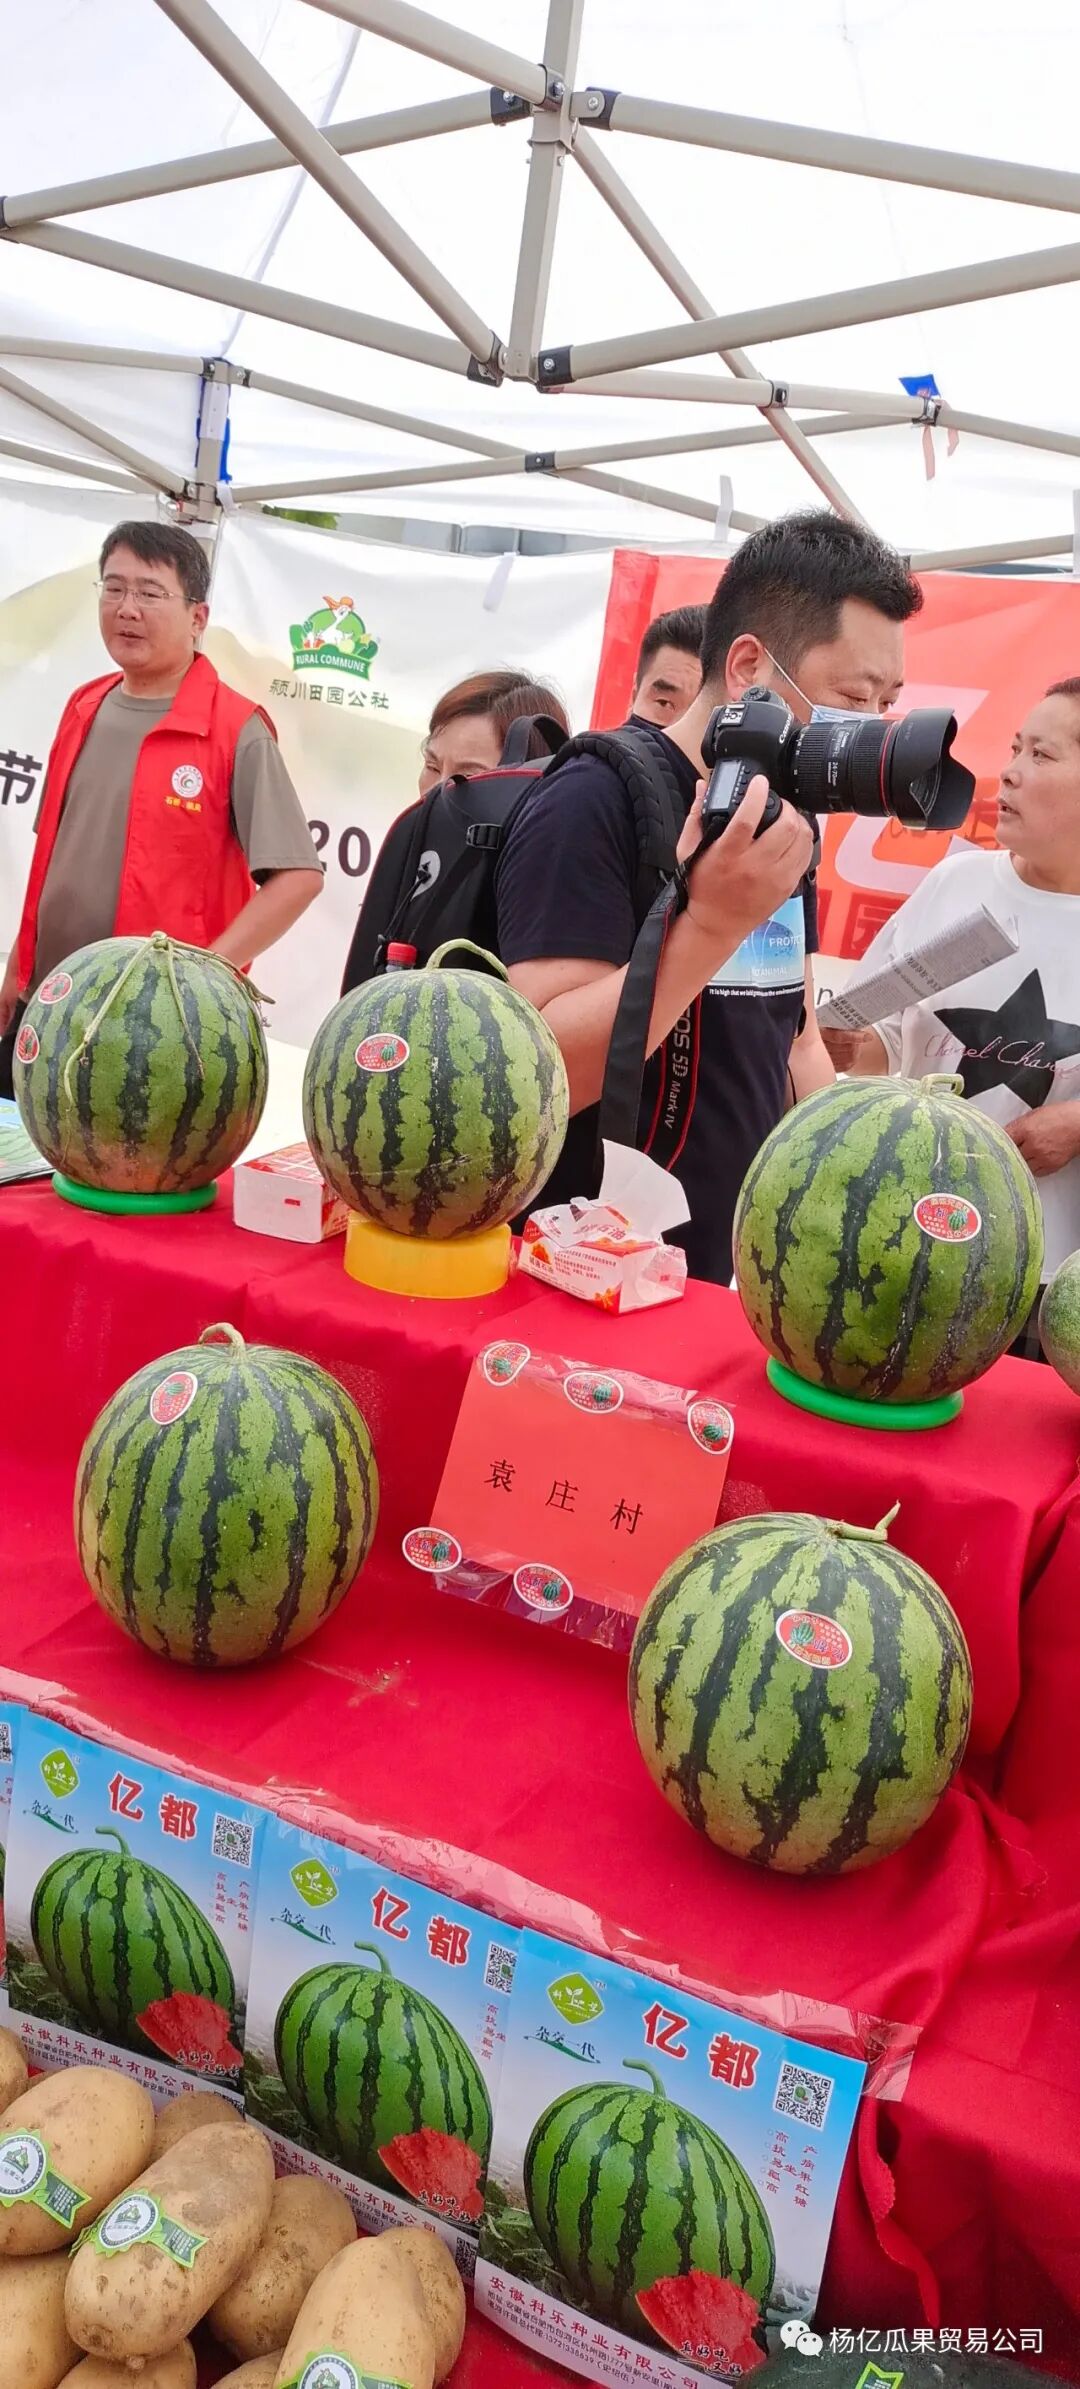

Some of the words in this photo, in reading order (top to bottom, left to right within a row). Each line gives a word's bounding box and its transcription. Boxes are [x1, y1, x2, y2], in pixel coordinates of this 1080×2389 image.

[296, 653, 319, 666] RURAL
[320, 654, 366, 673] COMMUNE
[779, 713, 792, 744] Canon
[666, 1080, 681, 1113] Mark
[672, 1053, 689, 1077] 5D
[663, 1117, 676, 1129] IV
[483, 1458, 644, 1535] 袁庄村
[107, 1771, 201, 1843] 亿都
[371, 1886, 471, 1968] 亿都
[21, 2022, 194, 2091] 安徽科乐种业有限公司
[642, 2001, 761, 2091] 亿都
[273, 2141, 436, 2232] 徽科乐种业有限公司
[489, 2276, 699, 2389] 安徽科乐种业有限公司
